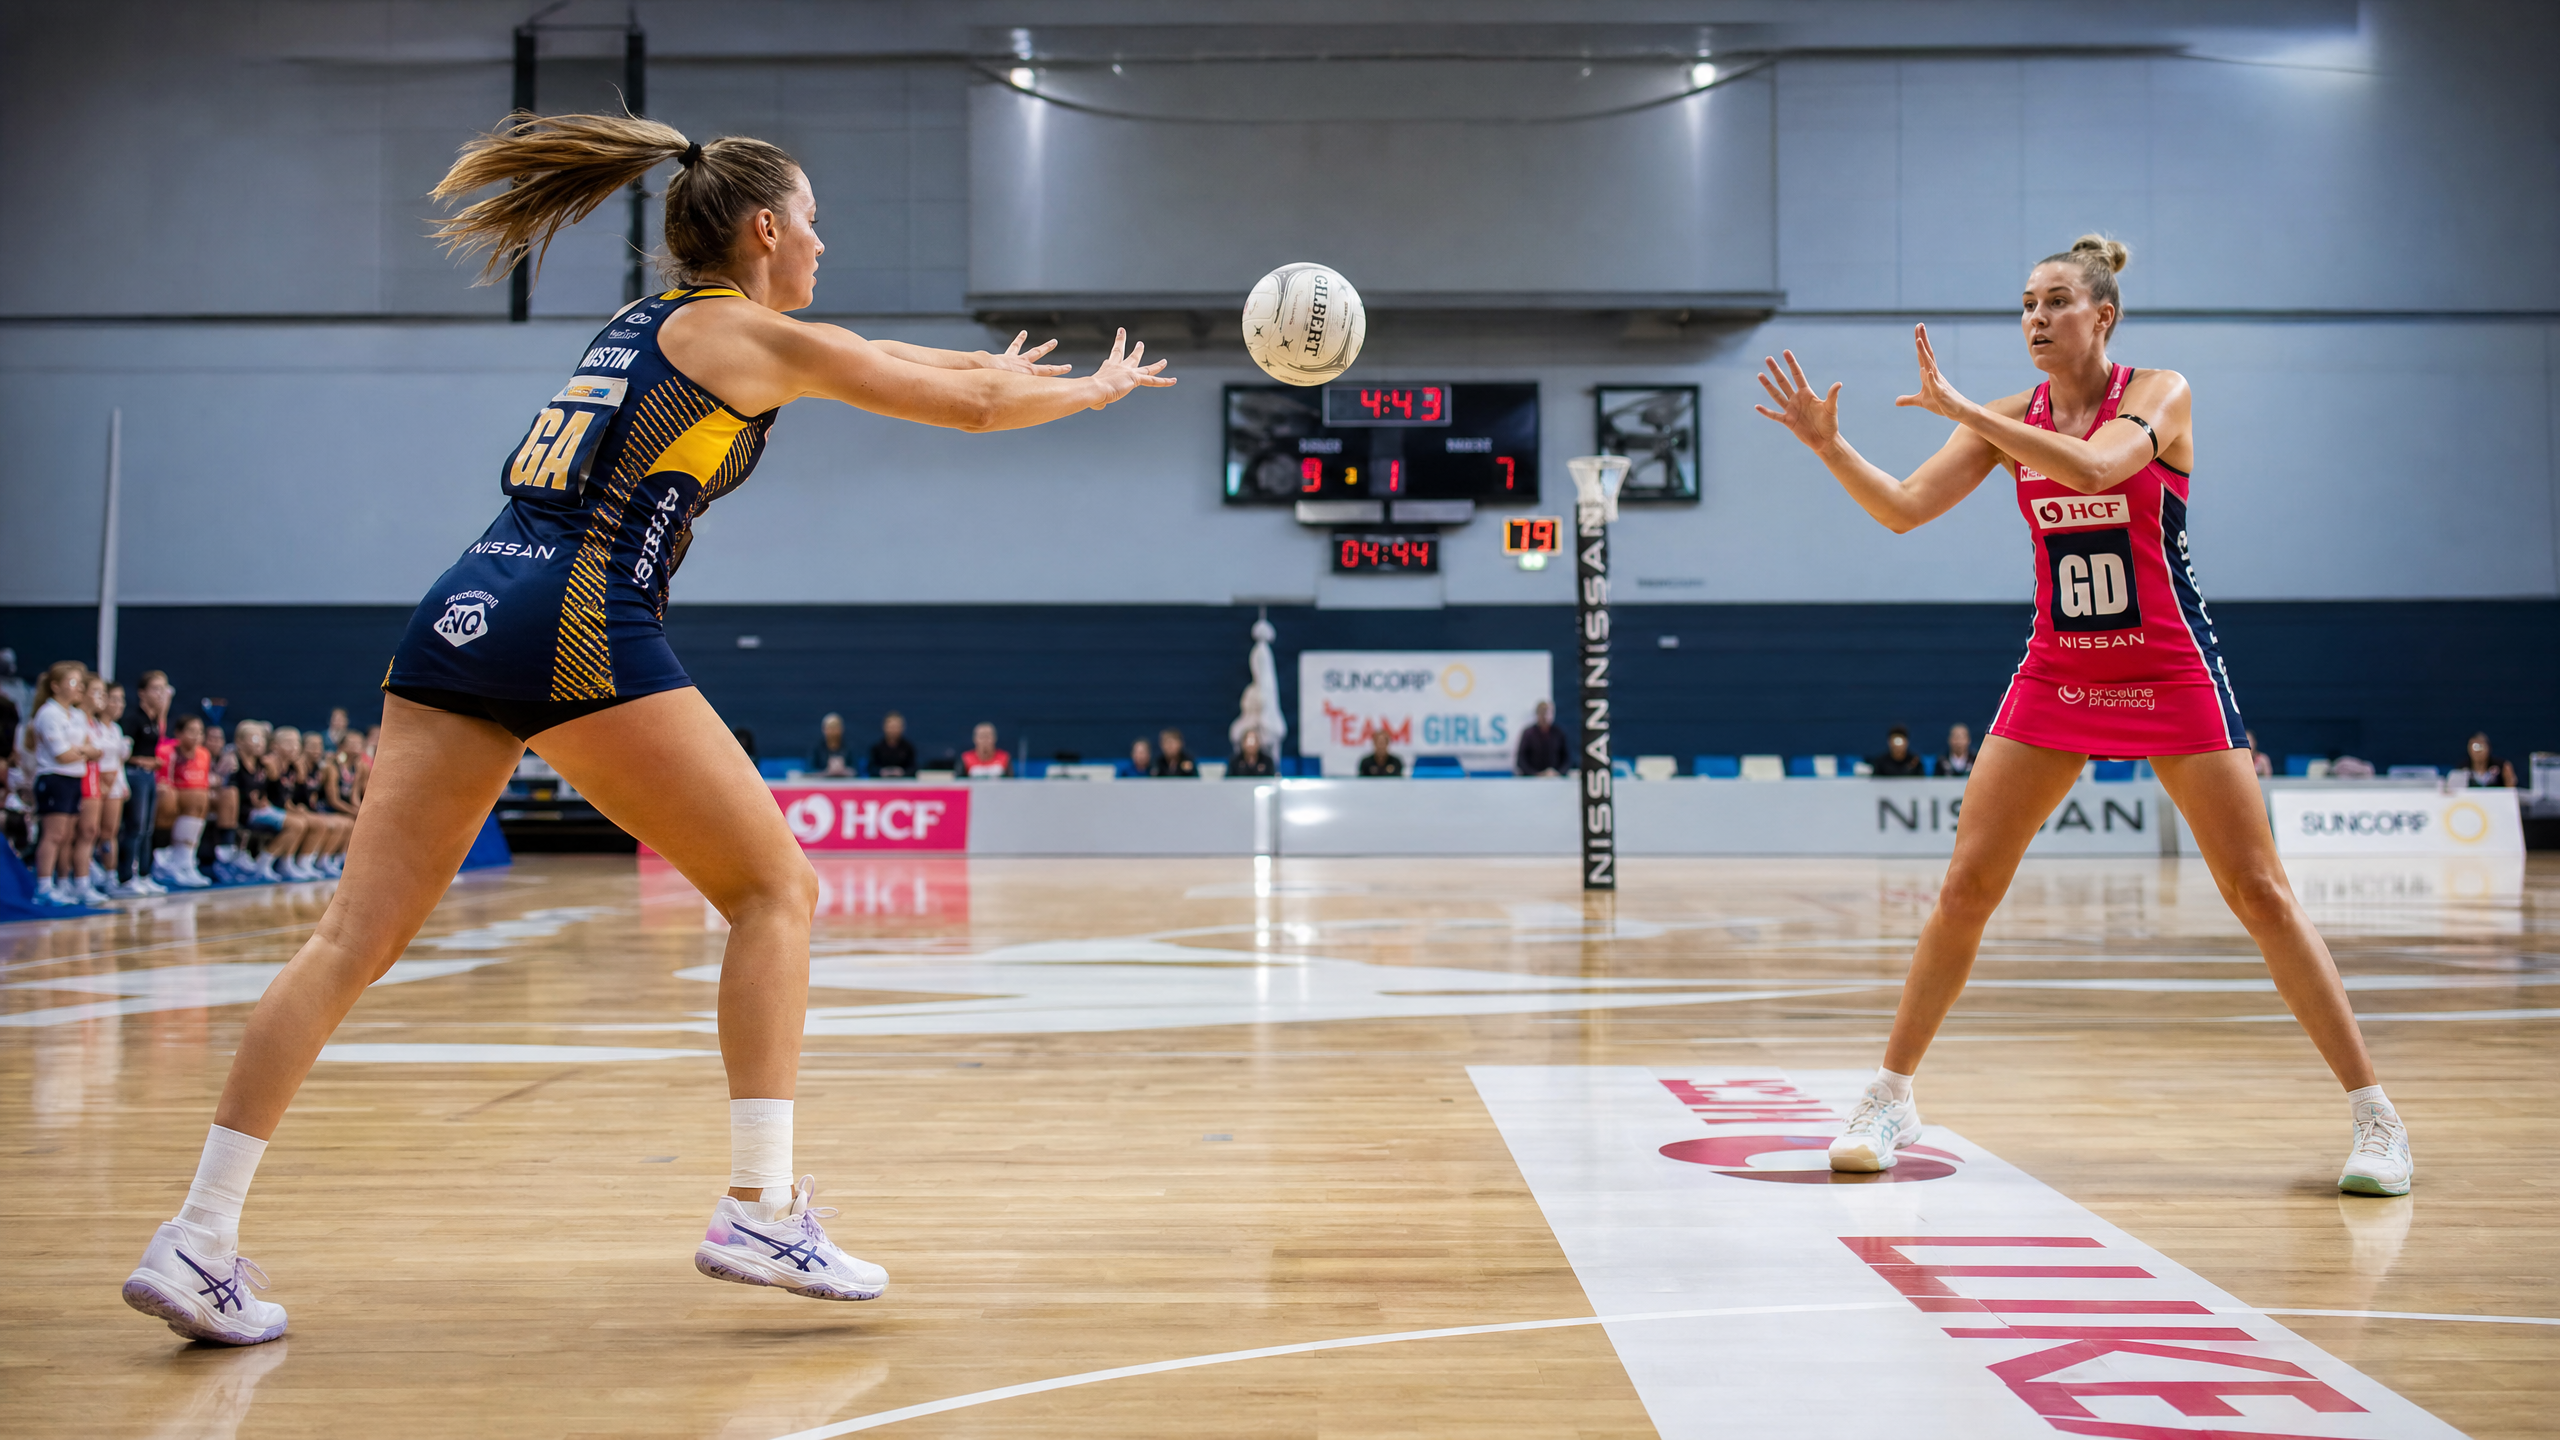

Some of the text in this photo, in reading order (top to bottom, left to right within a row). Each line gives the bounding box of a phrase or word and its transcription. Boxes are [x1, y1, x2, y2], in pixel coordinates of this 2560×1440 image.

[1360, 387, 1442, 421] 4:43
[509, 408, 596, 490] GA
[1495, 456, 1516, 490] 7
[2067, 501, 2121, 520] HCF
[469, 541, 556, 560] NISSAN
[1512, 518, 1554, 553] 79
[1341, 539, 1429, 568] 04:44
[1580, 502, 1611, 688] NISSAN
[2058, 553, 2128, 618] GD
[2059, 633, 2145, 649] NISSAN
[1323, 670, 1433, 692] SUNCORP
[2089, 696, 2155, 710] pharmacy
[1423, 714, 1507, 745] GIRLS
[1585, 698, 1613, 884] NISSAN
[841, 800, 946, 840] HCF
[1877, 798, 2145, 832] NIAN
[2301, 810, 2429, 835] SUNCORP
